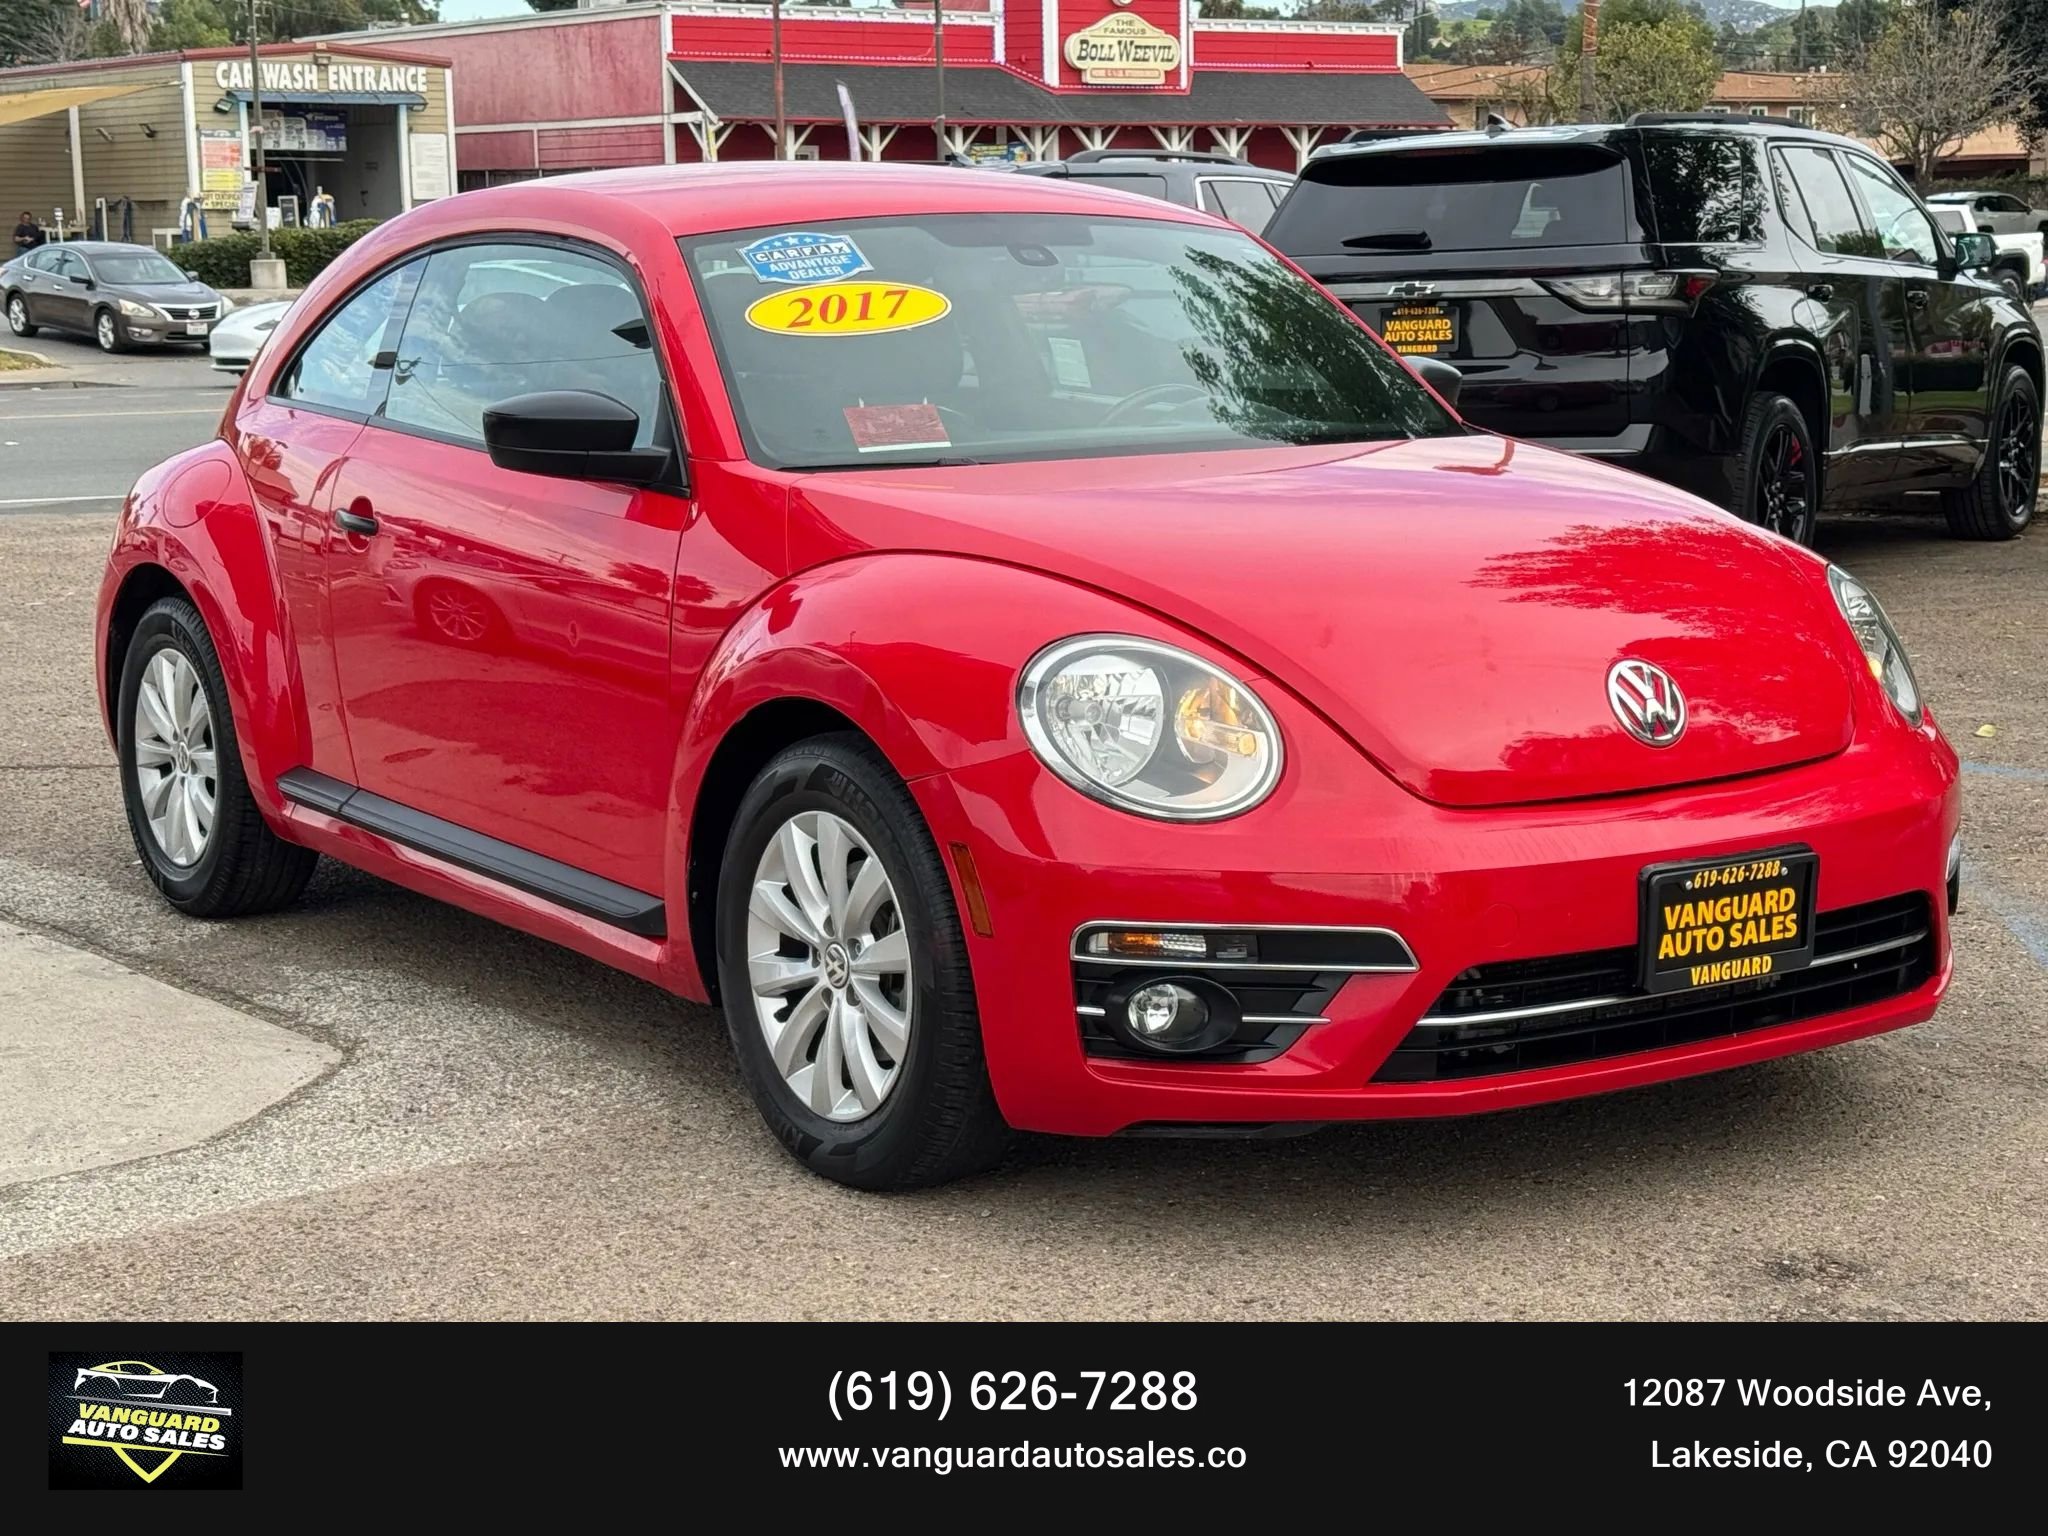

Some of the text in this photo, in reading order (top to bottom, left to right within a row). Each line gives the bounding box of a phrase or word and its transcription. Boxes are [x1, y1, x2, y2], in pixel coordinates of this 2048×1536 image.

[1103, 27, 1147, 35] FAMOUS
[1116, 19, 1135, 27] THE
[1077, 39, 1175, 62] BOLL WEEVIL
[262, 63, 319, 90] WASH
[328, 64, 428, 92] ENTRANCE
[753, 243, 851, 264] CARFAX
[770, 254, 852, 274] ADVANTAGE
[788, 265, 844, 281] DEALER
[786, 289, 910, 329] 2017
[1385, 318, 1452, 331] VANGUARD
[1384, 330, 1453, 342] AUTO SALES
[1396, 344, 1438, 353] VANGUARD
[1693, 860, 1781, 889] 619-626-7288
[1664, 887, 1796, 931] VANGUARD
[1658, 913, 1798, 960] AUTO SALES
[1690, 955, 1772, 986] VANGUARD
